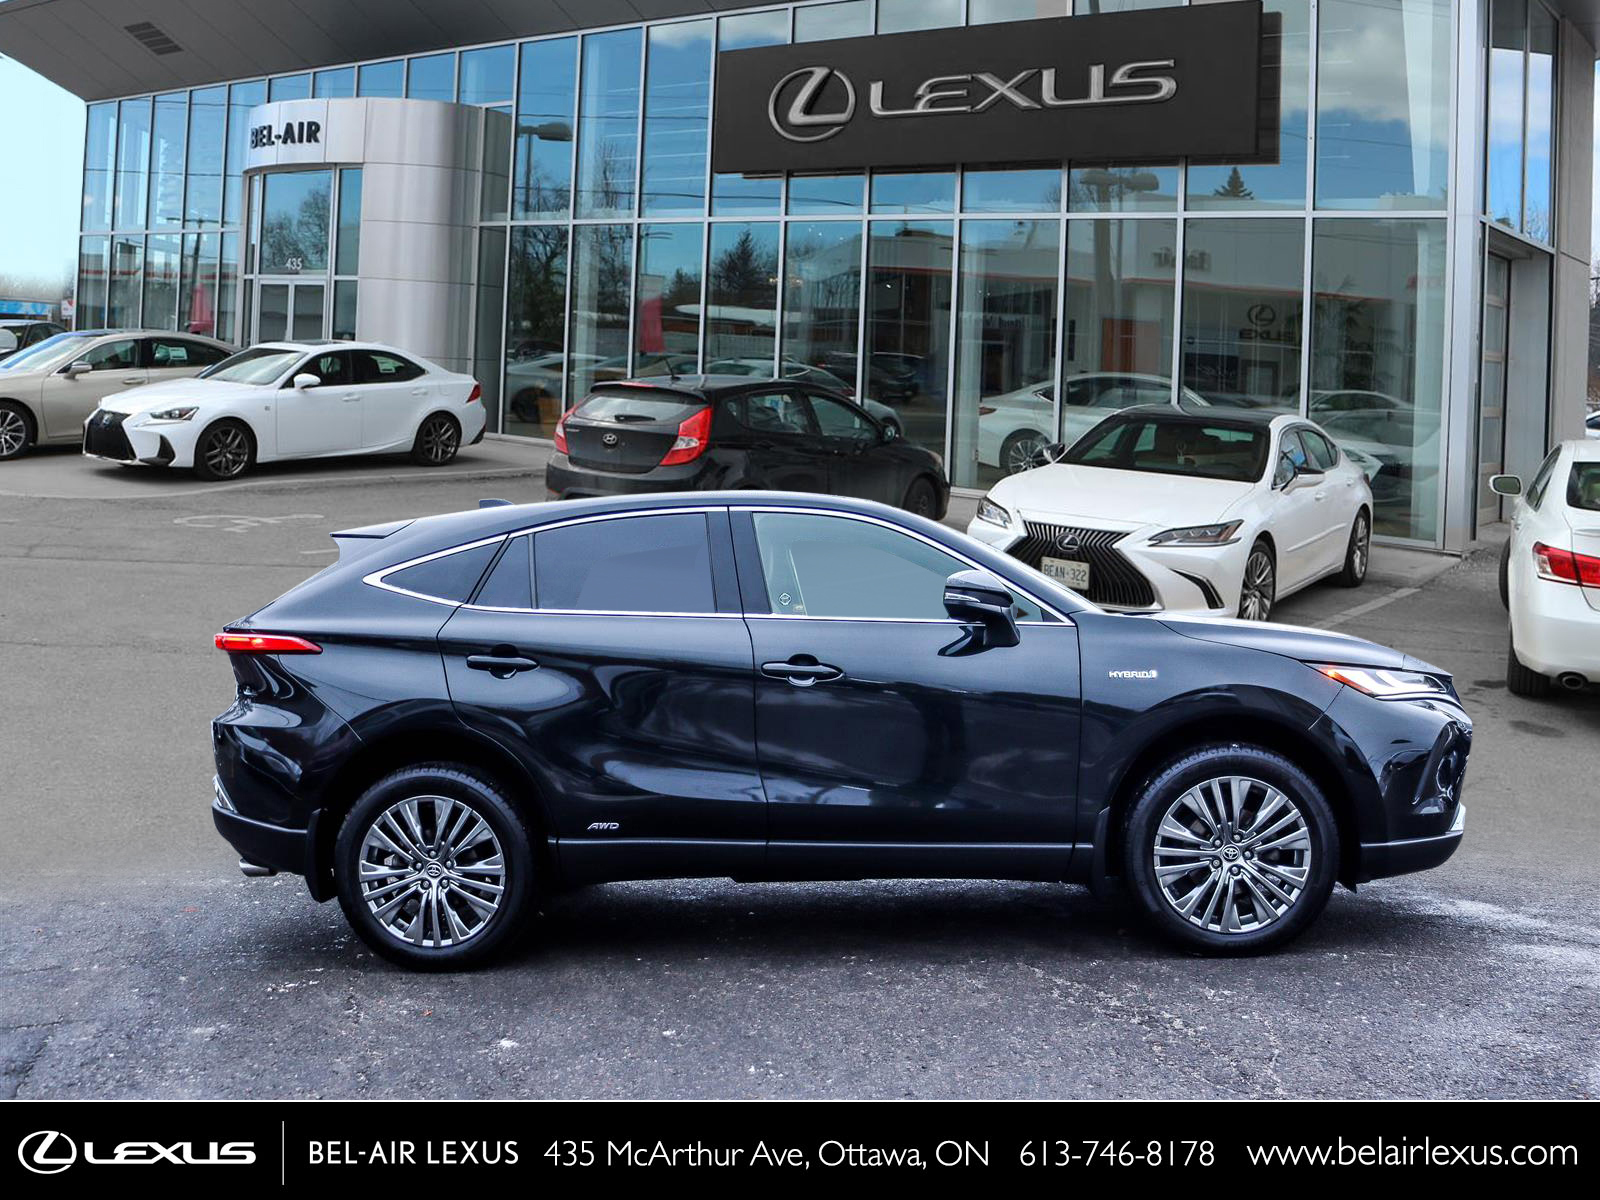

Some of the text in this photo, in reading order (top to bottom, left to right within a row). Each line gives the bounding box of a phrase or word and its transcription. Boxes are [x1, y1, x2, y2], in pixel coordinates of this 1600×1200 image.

[869, 59, 1178, 118] LEXUS
[250, 121, 321, 149] BEL-AIR
[285, 257, 303, 270] 435
[1108, 670, 1149, 679] HYBRID
[587, 822, 620, 830] AWD
